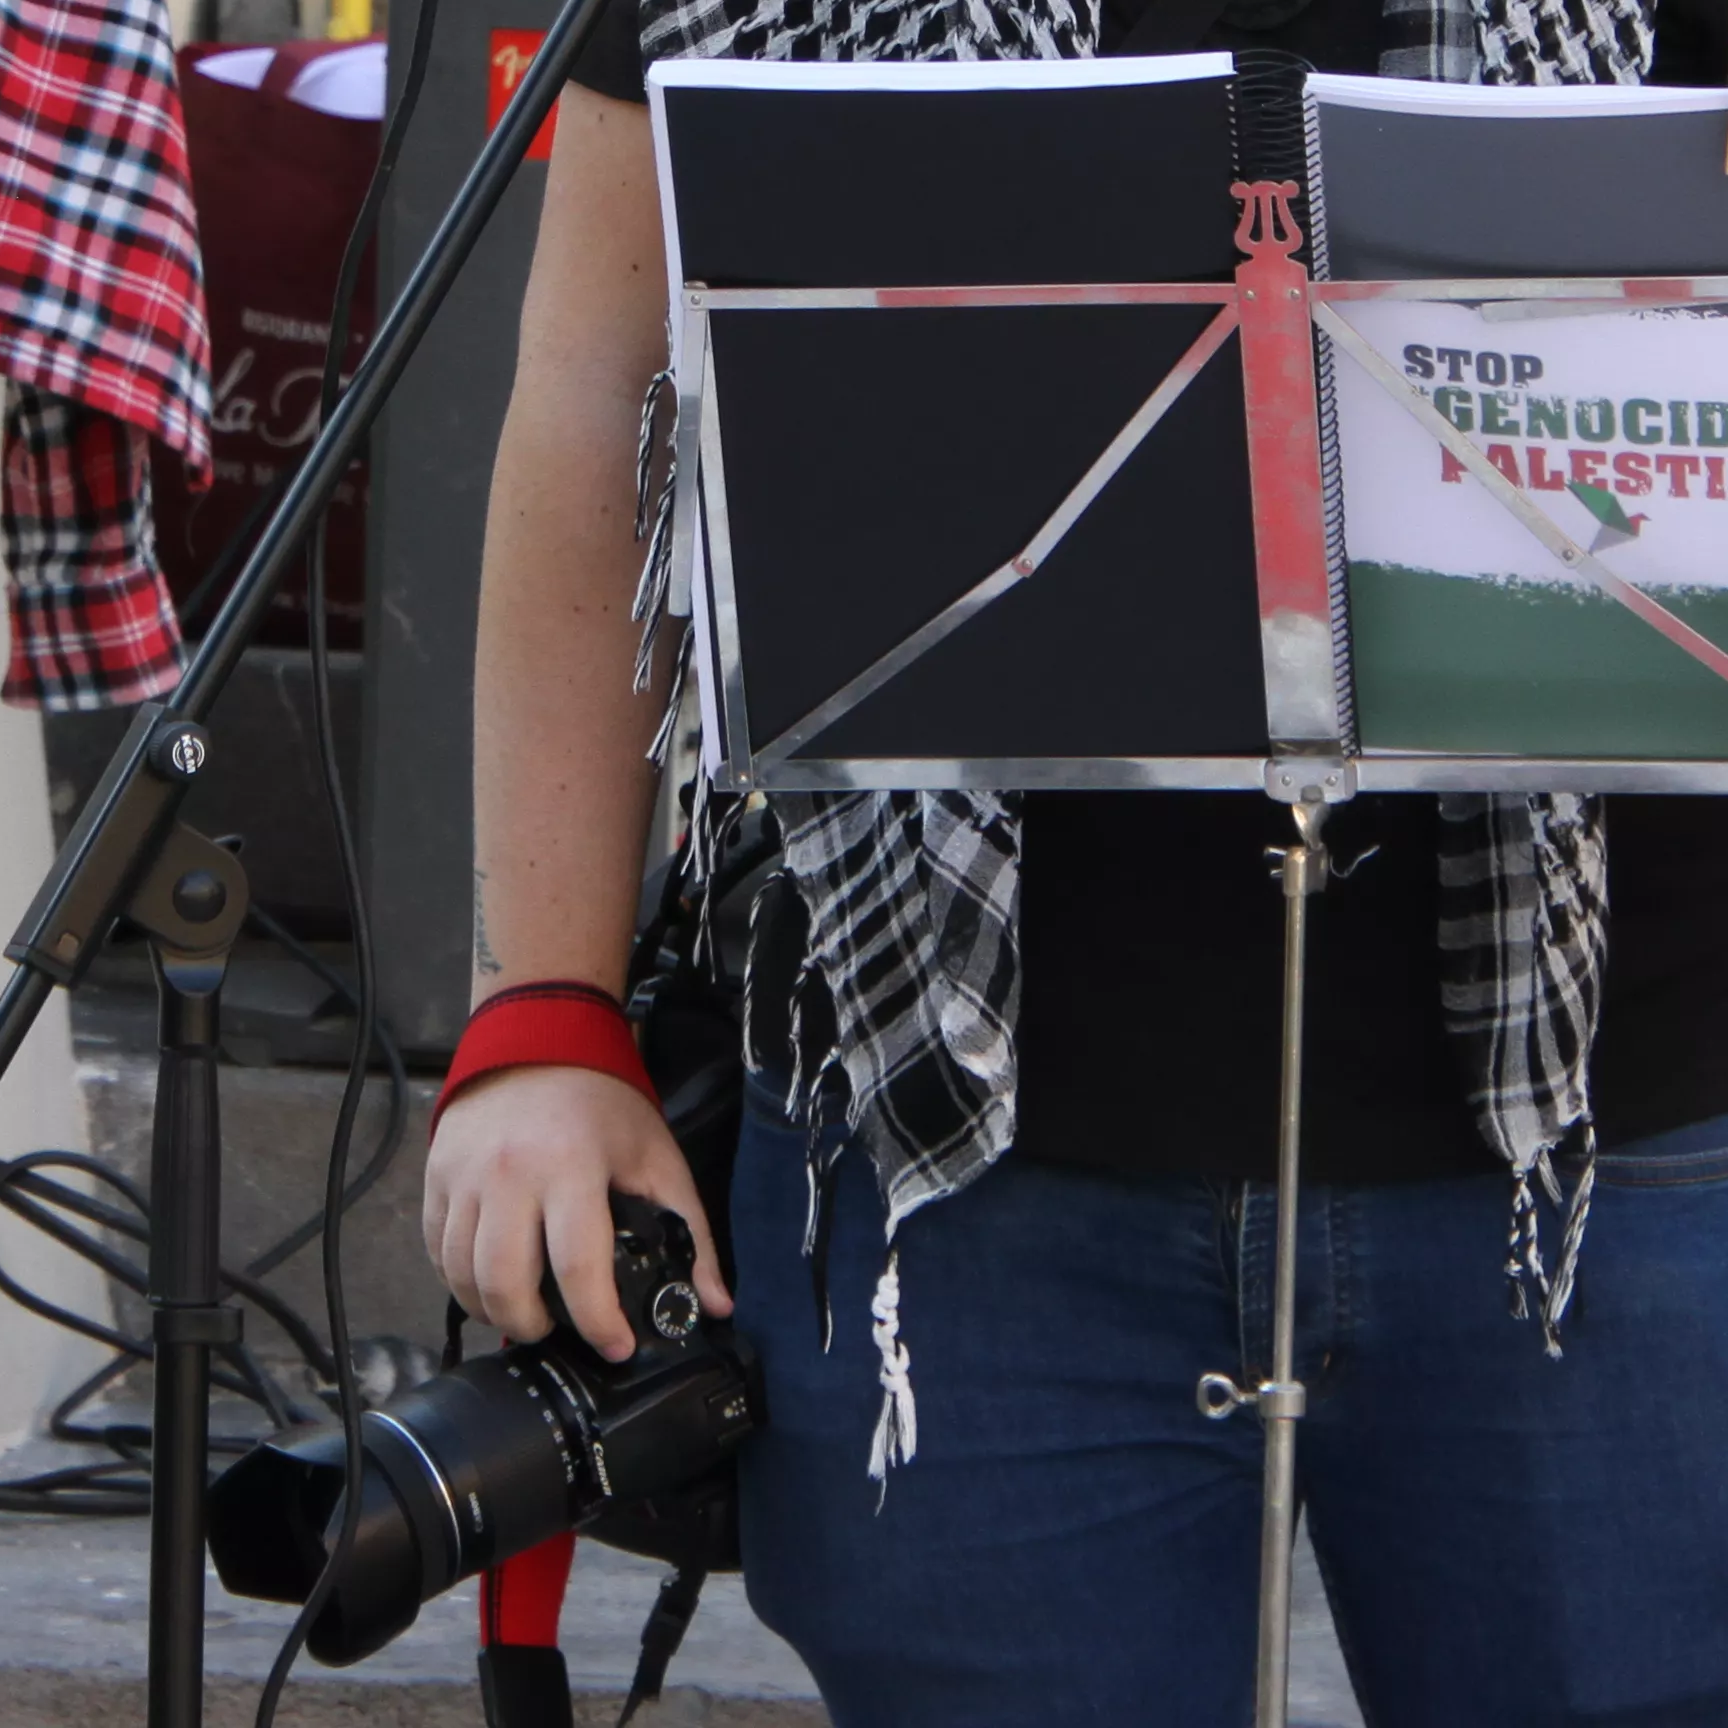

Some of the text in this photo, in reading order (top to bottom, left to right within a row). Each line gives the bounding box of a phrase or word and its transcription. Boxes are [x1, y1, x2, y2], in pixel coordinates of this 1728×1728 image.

[1403, 344, 1544, 388] STOP
[181, 734, 196, 774] K&M
[592, 1440, 613, 1496] Canon
